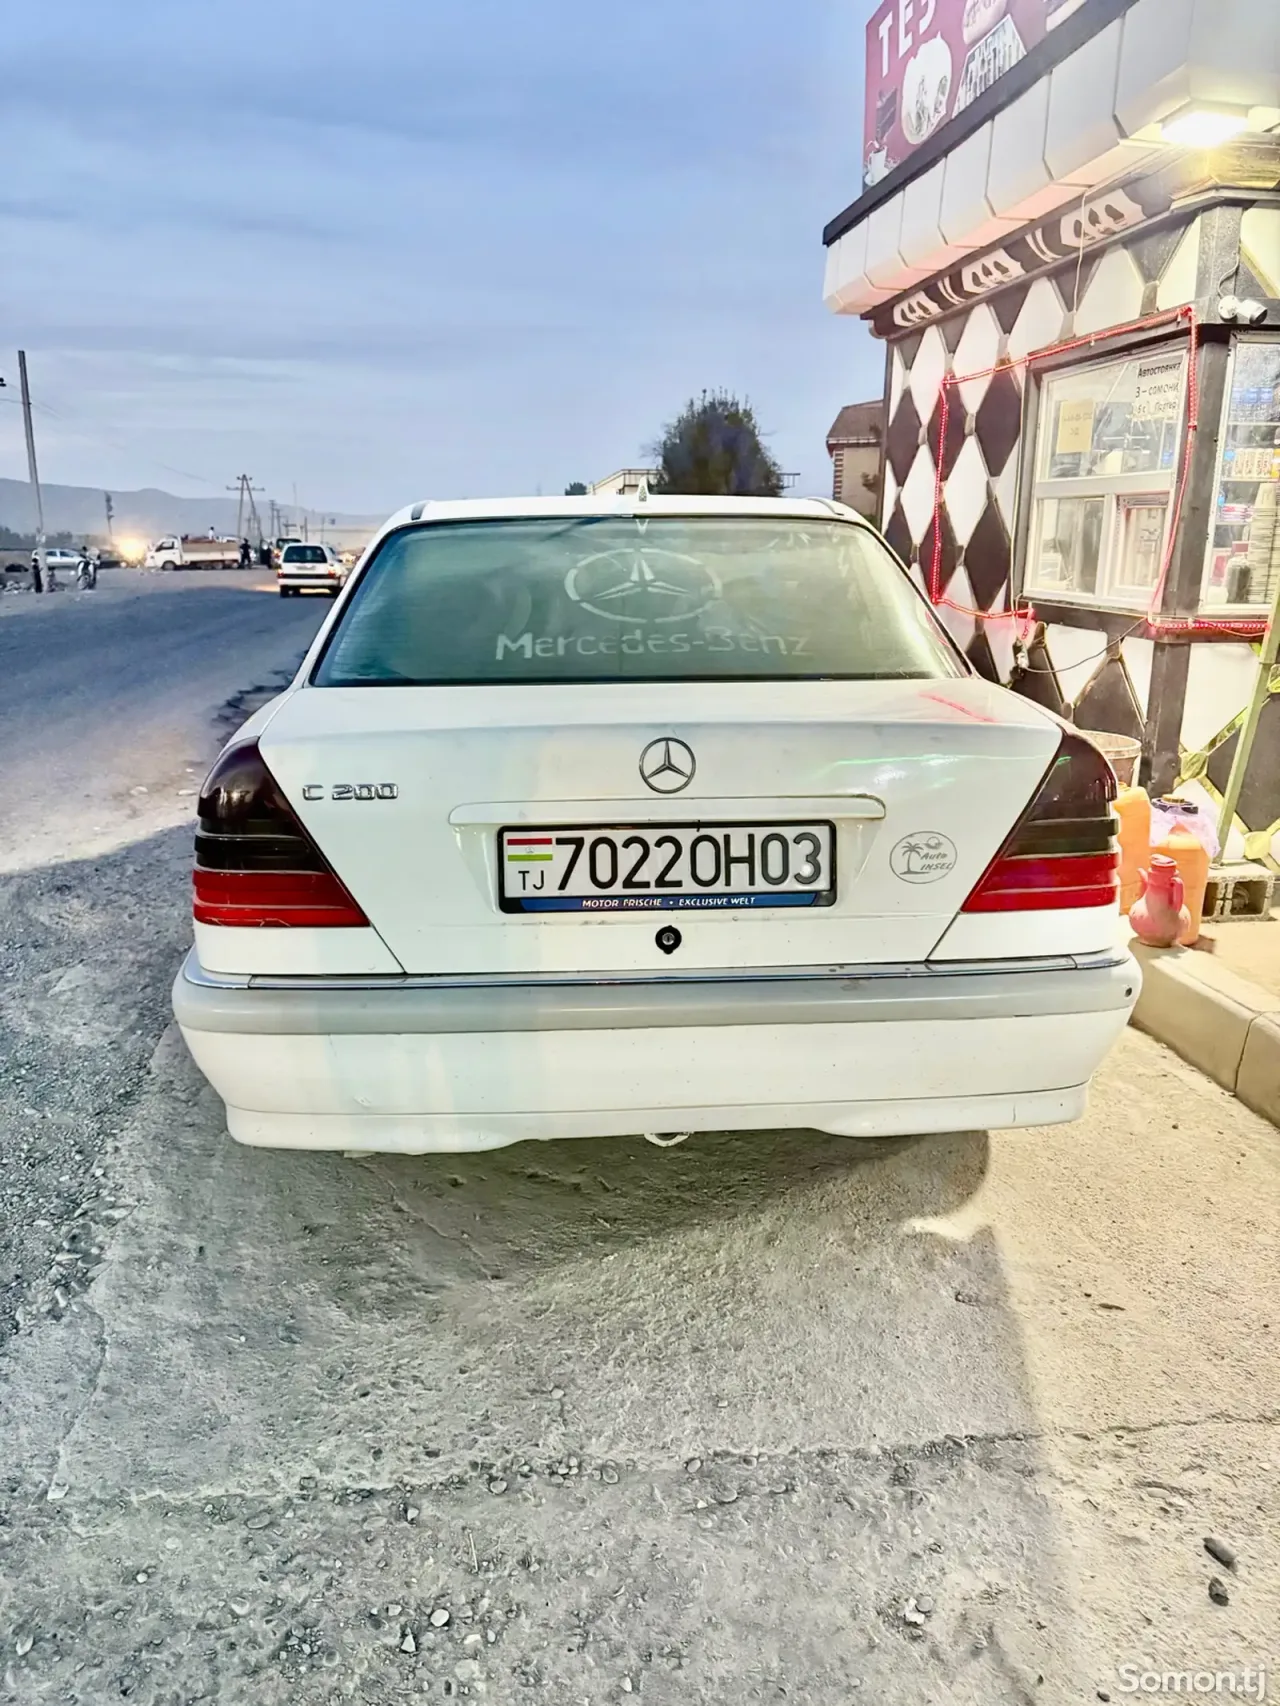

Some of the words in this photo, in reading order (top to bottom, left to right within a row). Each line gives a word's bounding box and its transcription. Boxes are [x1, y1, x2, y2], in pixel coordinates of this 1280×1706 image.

[495, 626, 808, 661] Mercedes-Benz
[302, 784, 324, 801] C
[331, 783, 399, 801] 200
[518, 870, 545, 891] TJ
[582, 899, 619, 908] MOTOR
[623, 898, 662, 908] FRISCHE
[678, 897, 728, 906] EXCLUSIVE
[730, 896, 756, 905] WELT
